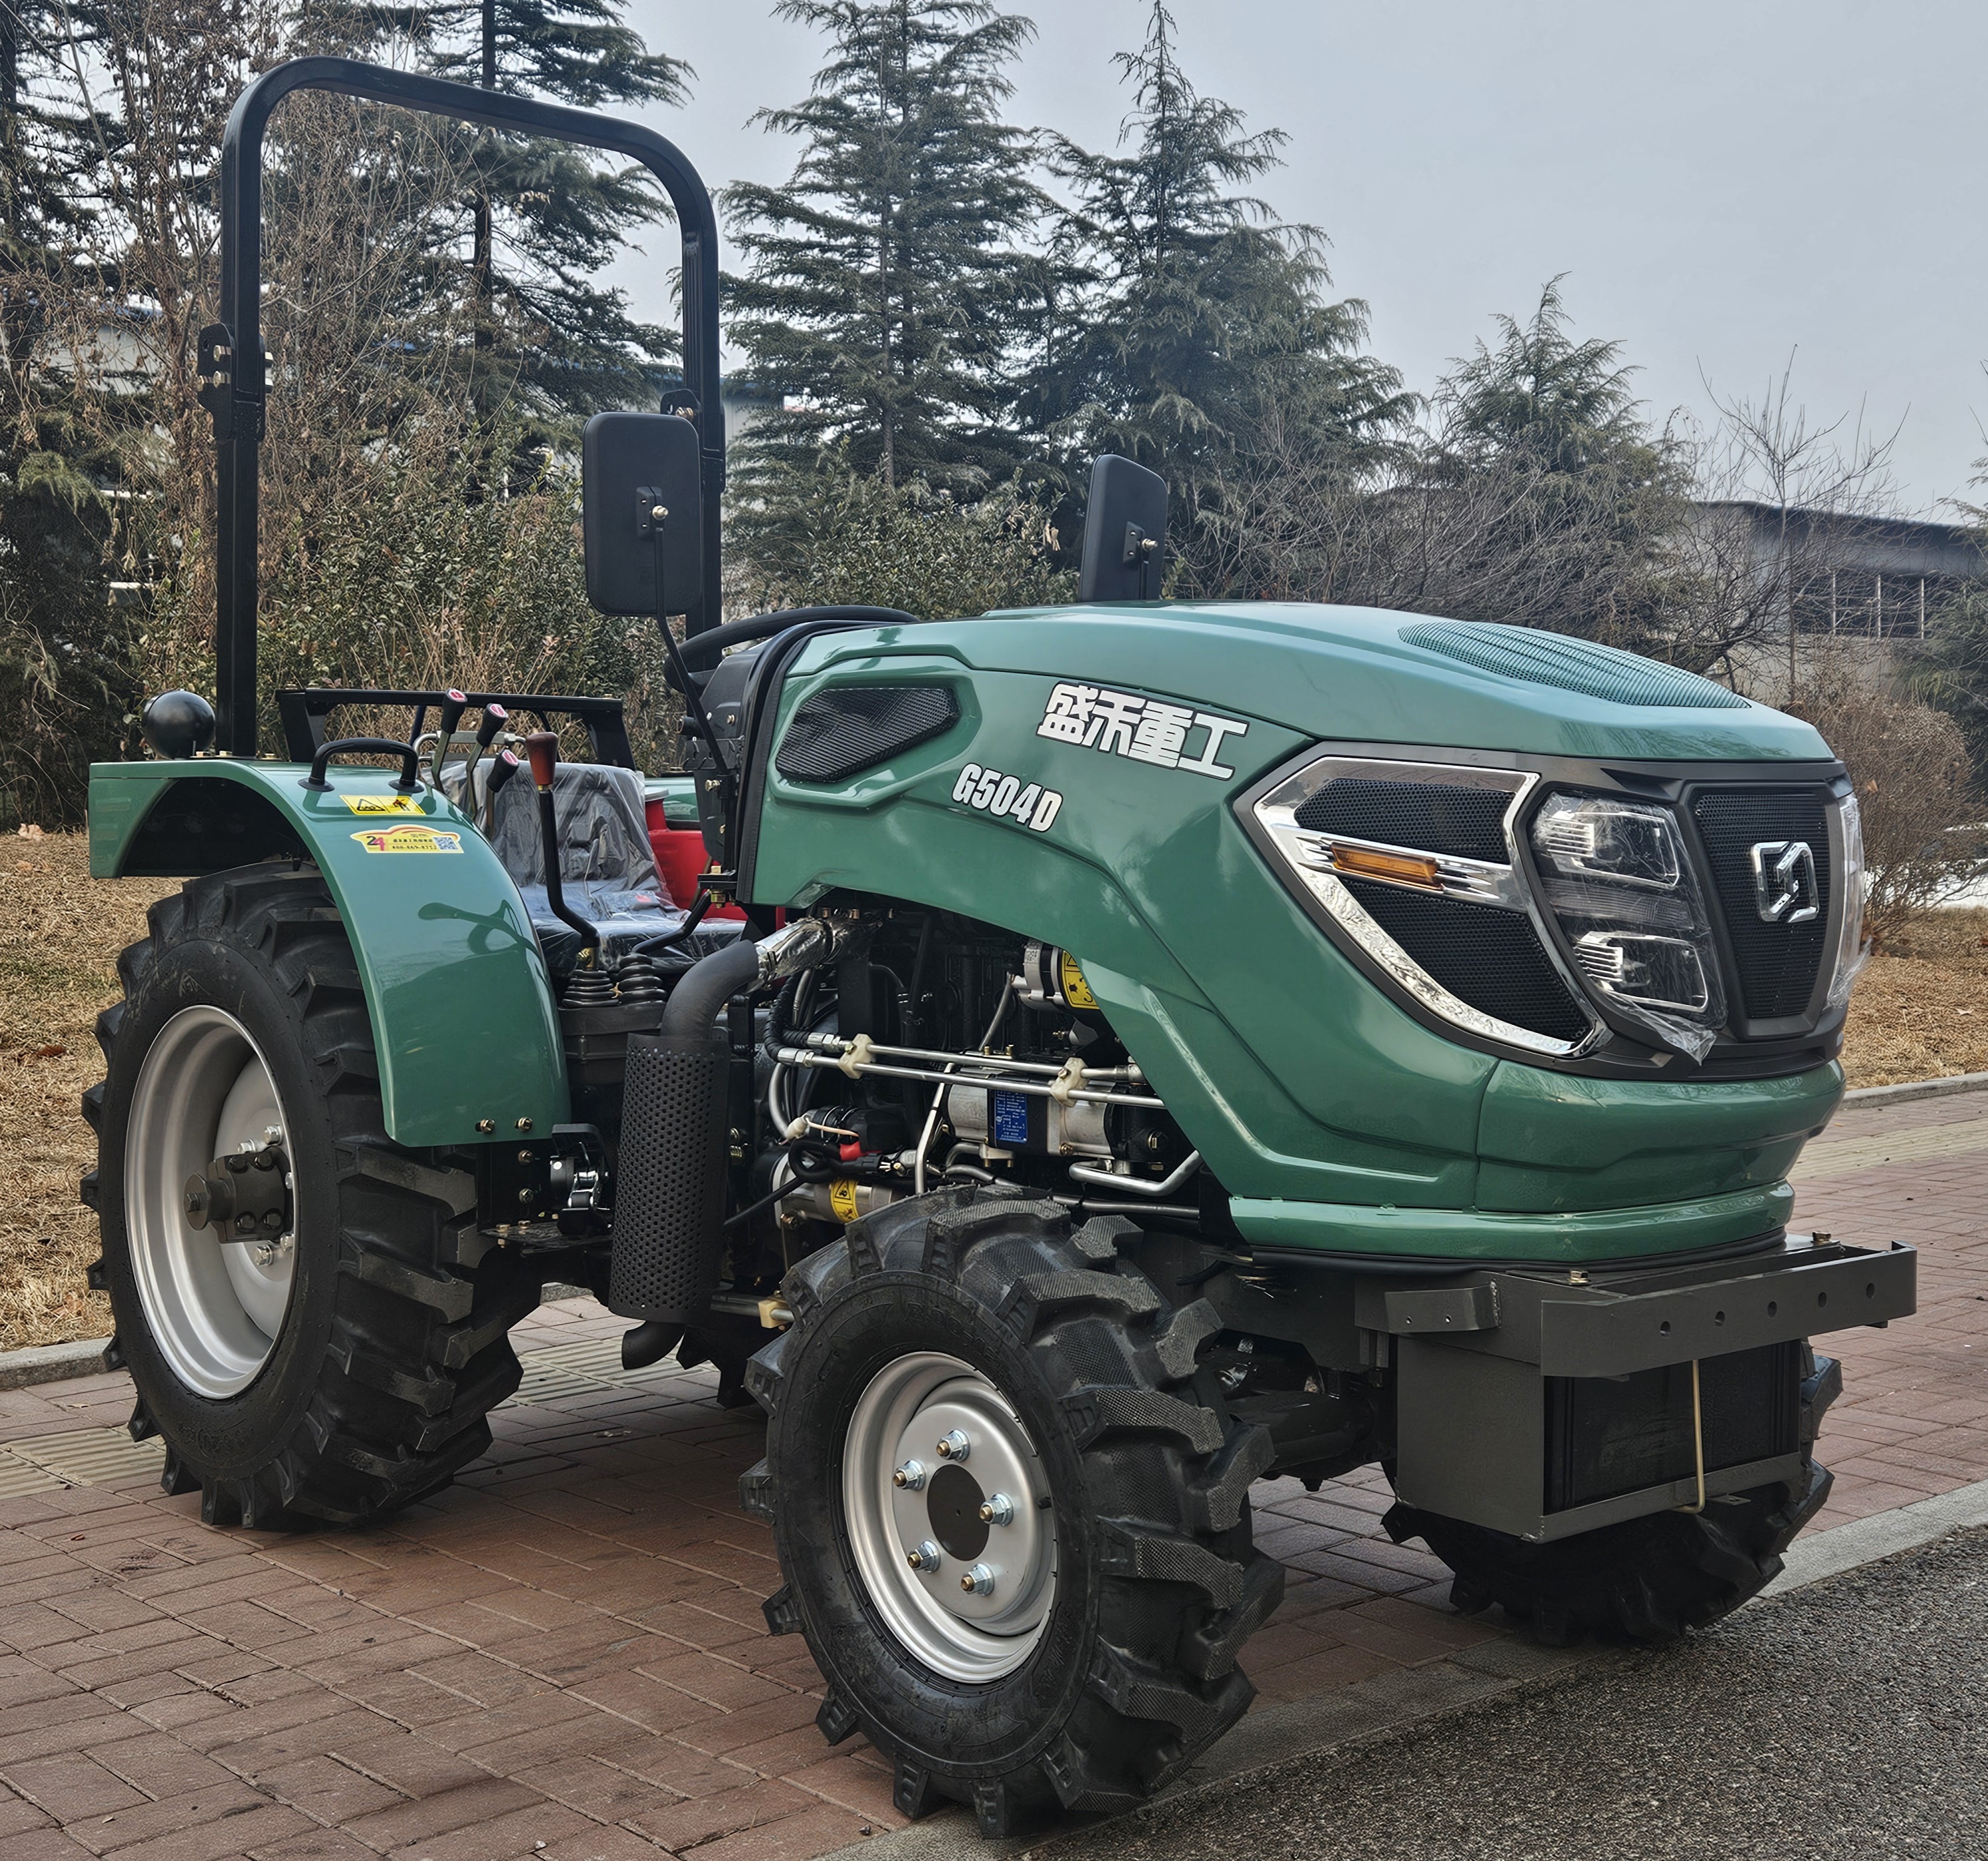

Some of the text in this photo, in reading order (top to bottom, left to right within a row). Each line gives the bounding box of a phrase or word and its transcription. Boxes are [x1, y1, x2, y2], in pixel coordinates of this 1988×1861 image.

[1037, 681, 1248, 780] 盛禾重工
[952, 763, 1063, 832] G504D
